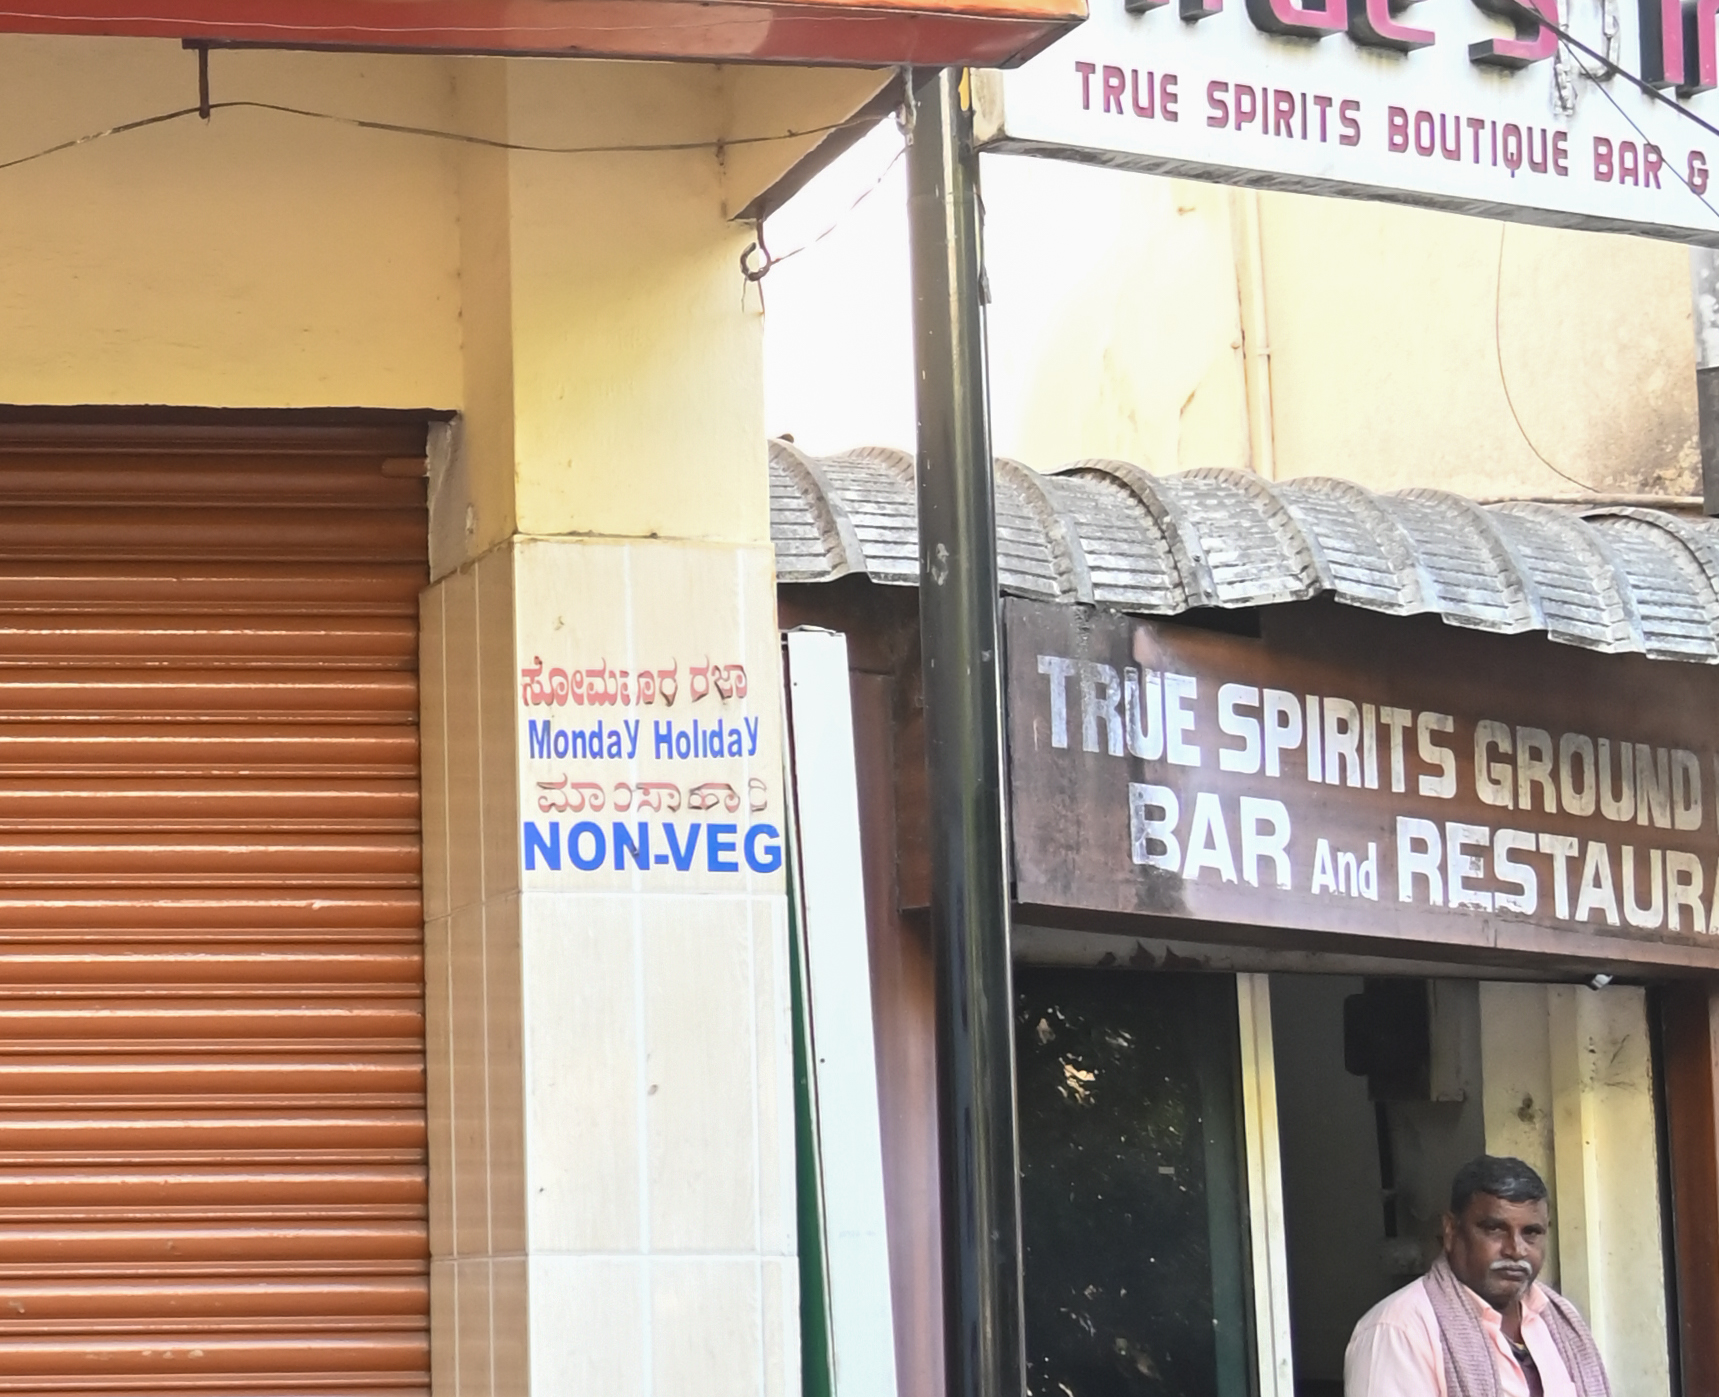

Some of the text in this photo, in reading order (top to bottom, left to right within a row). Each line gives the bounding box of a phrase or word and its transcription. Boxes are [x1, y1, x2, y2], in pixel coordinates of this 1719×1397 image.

[1075, 60, 1710, 196] TRUE SPIRITS BOUTIQUE BAR &
[528, 716, 759, 760] Monday Holiday
[1037, 654, 1703, 832] TRUE SPIRITS GROUND
[523, 820, 782, 874] NON-VEG
[1129, 782, 1719, 936] BAR And RESTAUR
